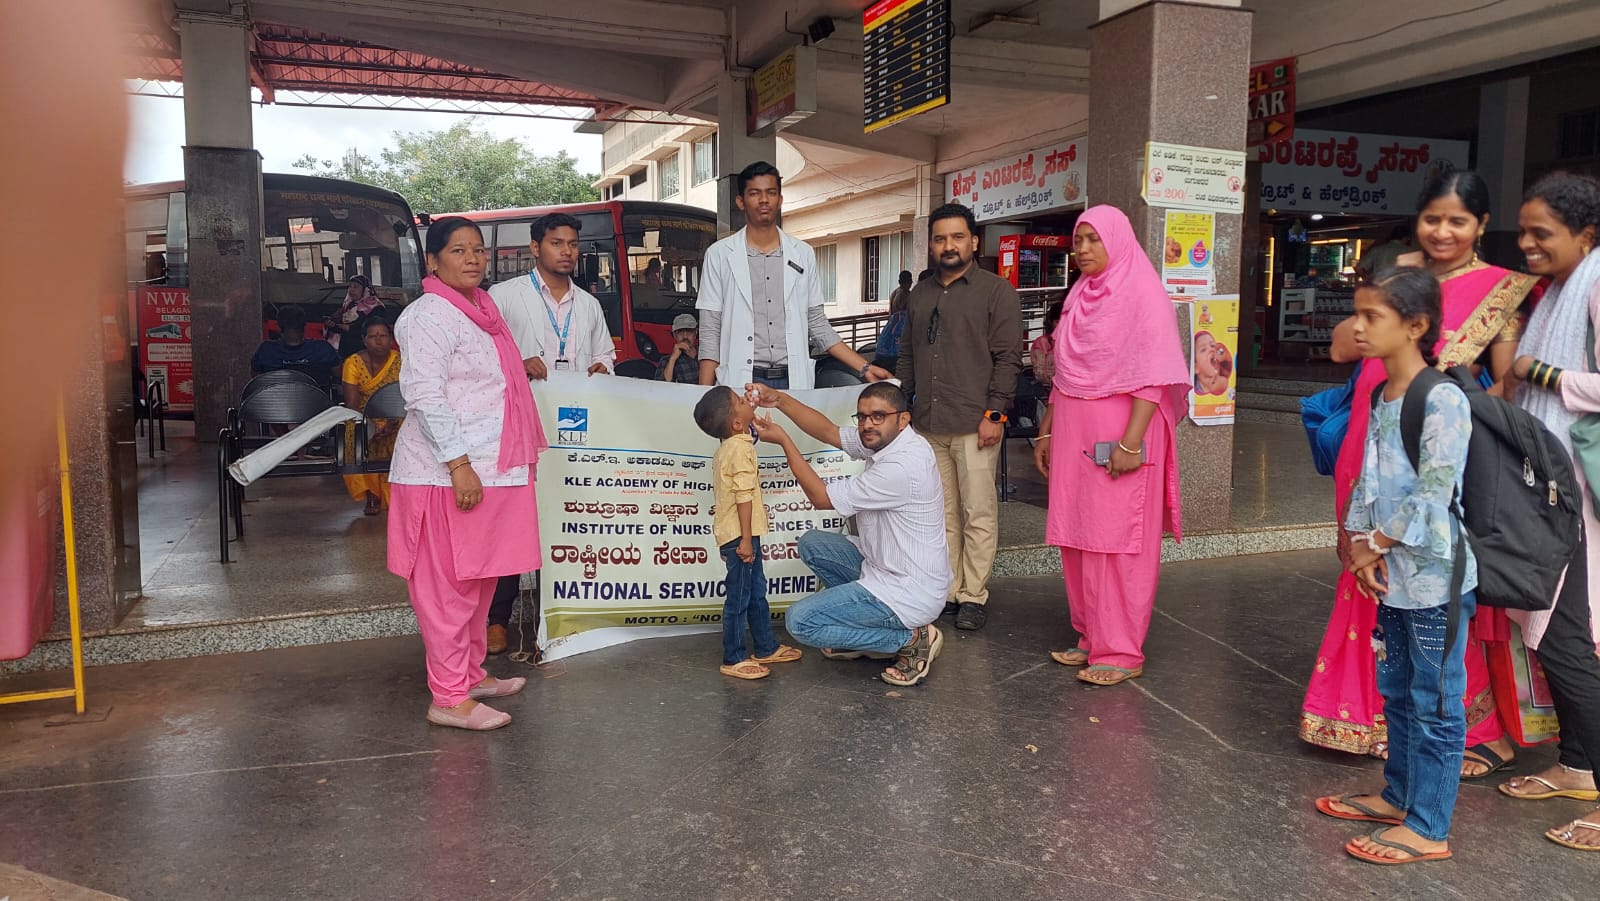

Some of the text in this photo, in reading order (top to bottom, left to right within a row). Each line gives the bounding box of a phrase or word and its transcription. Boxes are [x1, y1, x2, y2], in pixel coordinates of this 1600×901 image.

[1302, 185, 1312, 200] &
[146, 292, 190, 306] NWK
[558, 431, 588, 442] KLE
[564, 476, 592, 487] KLE
[596, 477, 659, 489] ACADEMY
[662, 479, 680, 489] OF
[684, 481, 714, 492] HIGH
[649, 502, 699, 522] ವಿಜ್ಞಾನ
[562, 522, 645, 535] INSTITUTE
[649, 524, 668, 535] OF
[672, 524, 714, 536] NURS
[767, 519, 818, 534] ENCES,
[653, 540, 708, 566] ಸೇವಾ
[553, 575, 816, 601] NATIONAL SERVIC HEME
[624, 615, 678, 625] MOTTO
